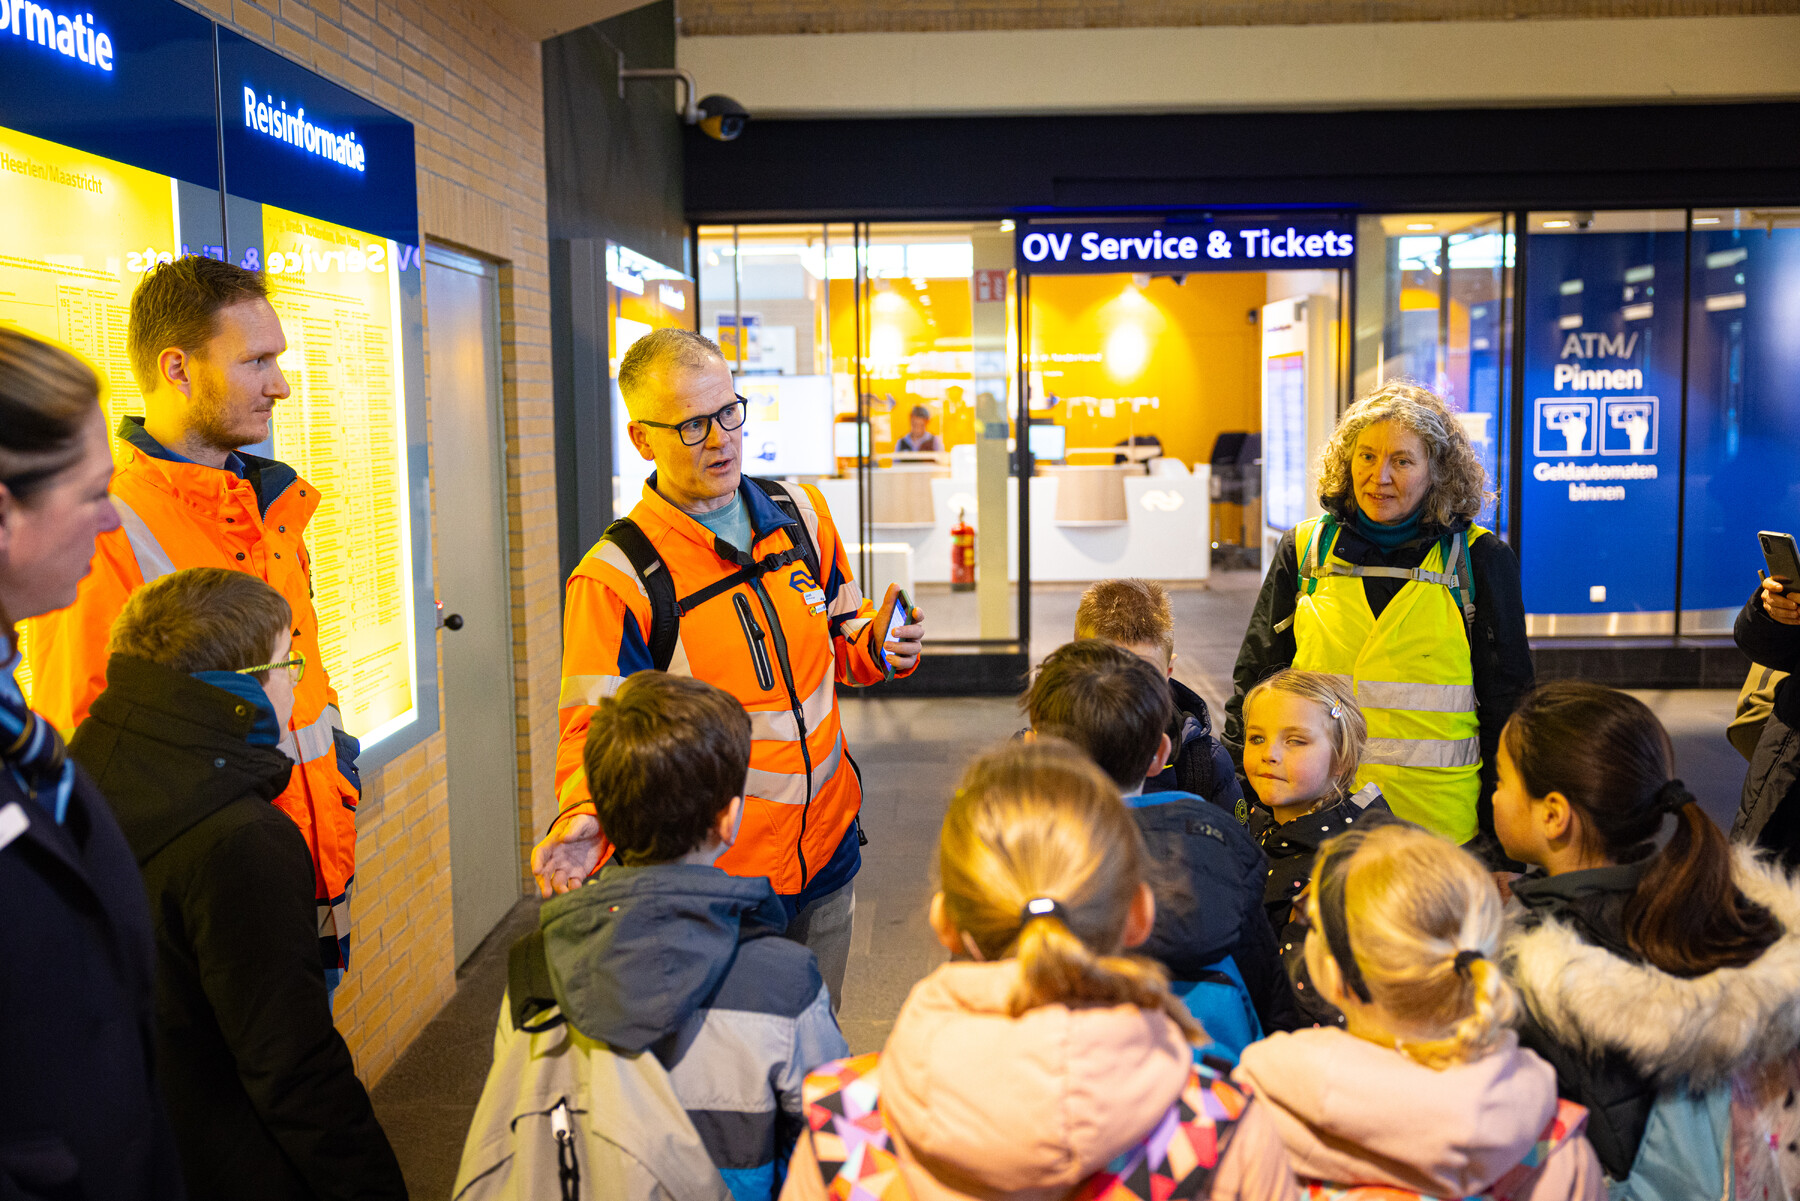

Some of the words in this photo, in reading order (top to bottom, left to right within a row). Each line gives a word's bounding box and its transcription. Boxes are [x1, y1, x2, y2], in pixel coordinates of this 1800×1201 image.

[244, 86, 365, 172] Reisinformatie
[1, 152, 103, 194] Heerlen/Maastricht
[1022, 232, 1073, 263] OV
[1081, 230, 1198, 261] Service
[1207, 229, 1232, 260] &
[1240, 227, 1354, 259] Tickets
[1560, 331, 1638, 360] ATM/
[1553, 363, 1643, 391] Pinnen
[1533, 462, 1658, 482] Geldautomaten
[1568, 482, 1625, 502] binnen
